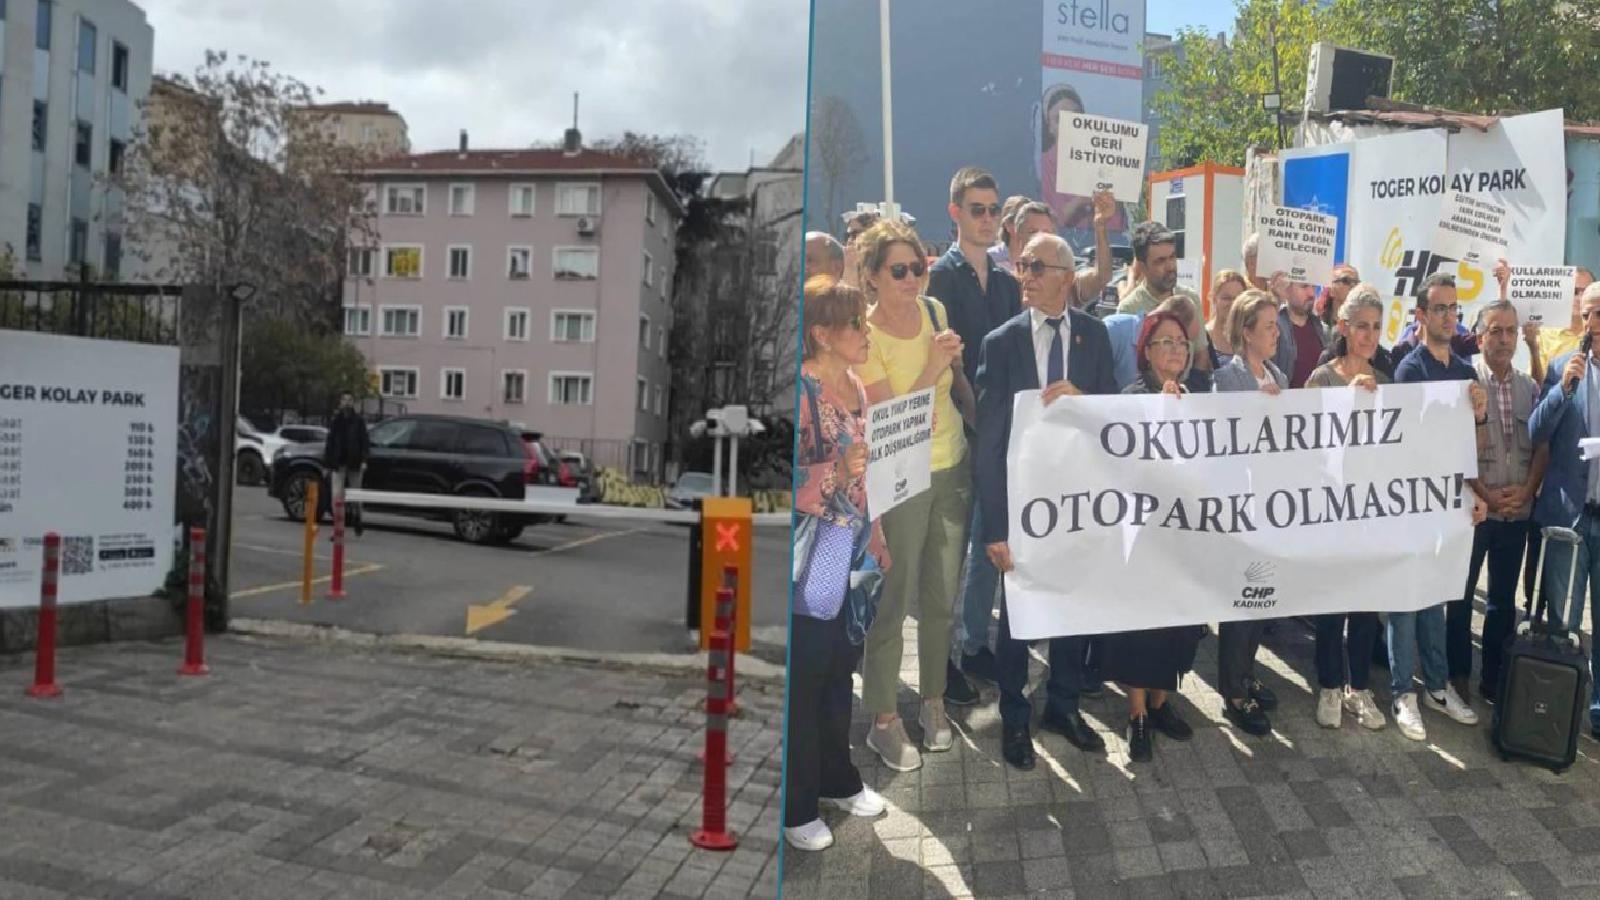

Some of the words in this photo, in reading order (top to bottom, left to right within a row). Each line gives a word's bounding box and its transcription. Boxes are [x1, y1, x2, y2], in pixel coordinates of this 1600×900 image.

[1058, 0, 1128, 34] stella
[1073, 118, 1139, 138] OKULUMU
[1091, 137, 1122, 150] GERİ
[1070, 147, 1140, 169] İSTİYORUM
[1370, 177, 1415, 199] TOGER
[1478, 168, 1527, 192] PARK
[1261, 217, 1295, 229] DEĞİL
[1276, 208, 1326, 223] OTOPARK
[1268, 229, 1299, 240] RANT
[1511, 278, 1561, 288] OTOPARK
[41, 386, 98, 404] KOLAY
[102, 390, 146, 407] PARK
[1100, 407, 1403, 460] OKULLARIMIZ
[1020, 488, 1258, 539] OTOPARK
[1265, 472, 1464, 529] OLMASIN!
[1242, 587, 1275, 599] CHP
